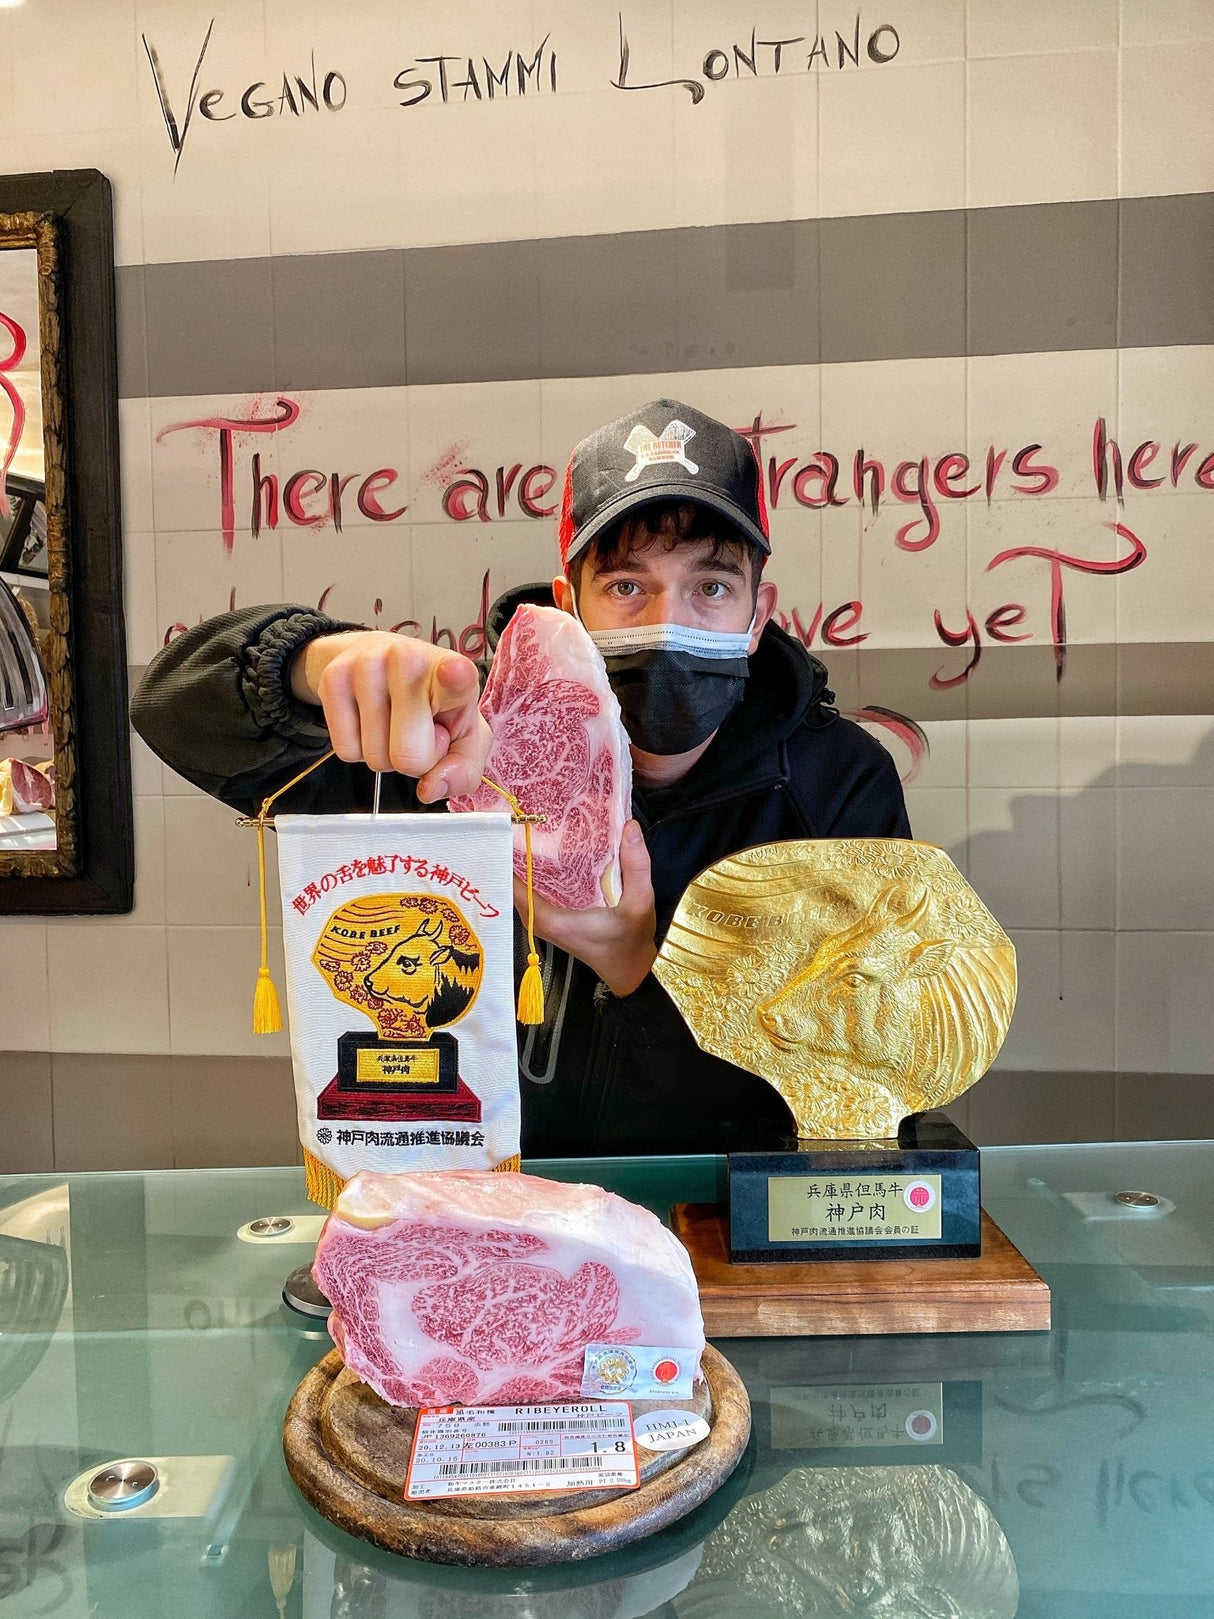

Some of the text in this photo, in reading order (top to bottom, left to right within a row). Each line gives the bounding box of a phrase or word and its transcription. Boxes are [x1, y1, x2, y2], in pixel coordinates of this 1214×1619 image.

[393, 32, 558, 106] STAMMI
[610, 11, 900, 104] LONTANO
[157, 396, 408, 553] There
[441, 463, 560, 522] are
[735, 411, 1059, 552] trangers
[291, 854, 501, 919] 世界の舌を魅了する神戸ビーフ
[685, 903, 761, 929] KOBE
[330, 924, 402, 940] KOBE BEEF
[336, 1129, 485, 1147] 神戸肉流通推進協議会
[806, 1182, 904, 1200] 兵庫県但馬牛
[825, 1203, 886, 1222] 神戸肉
[791, 1226, 920, 1237] 神戸肉流通推進協議会会員の証
[515, 1404, 607, 1415] RIBEYEROLL
[649, 1428, 697, 1443] JAPAN
